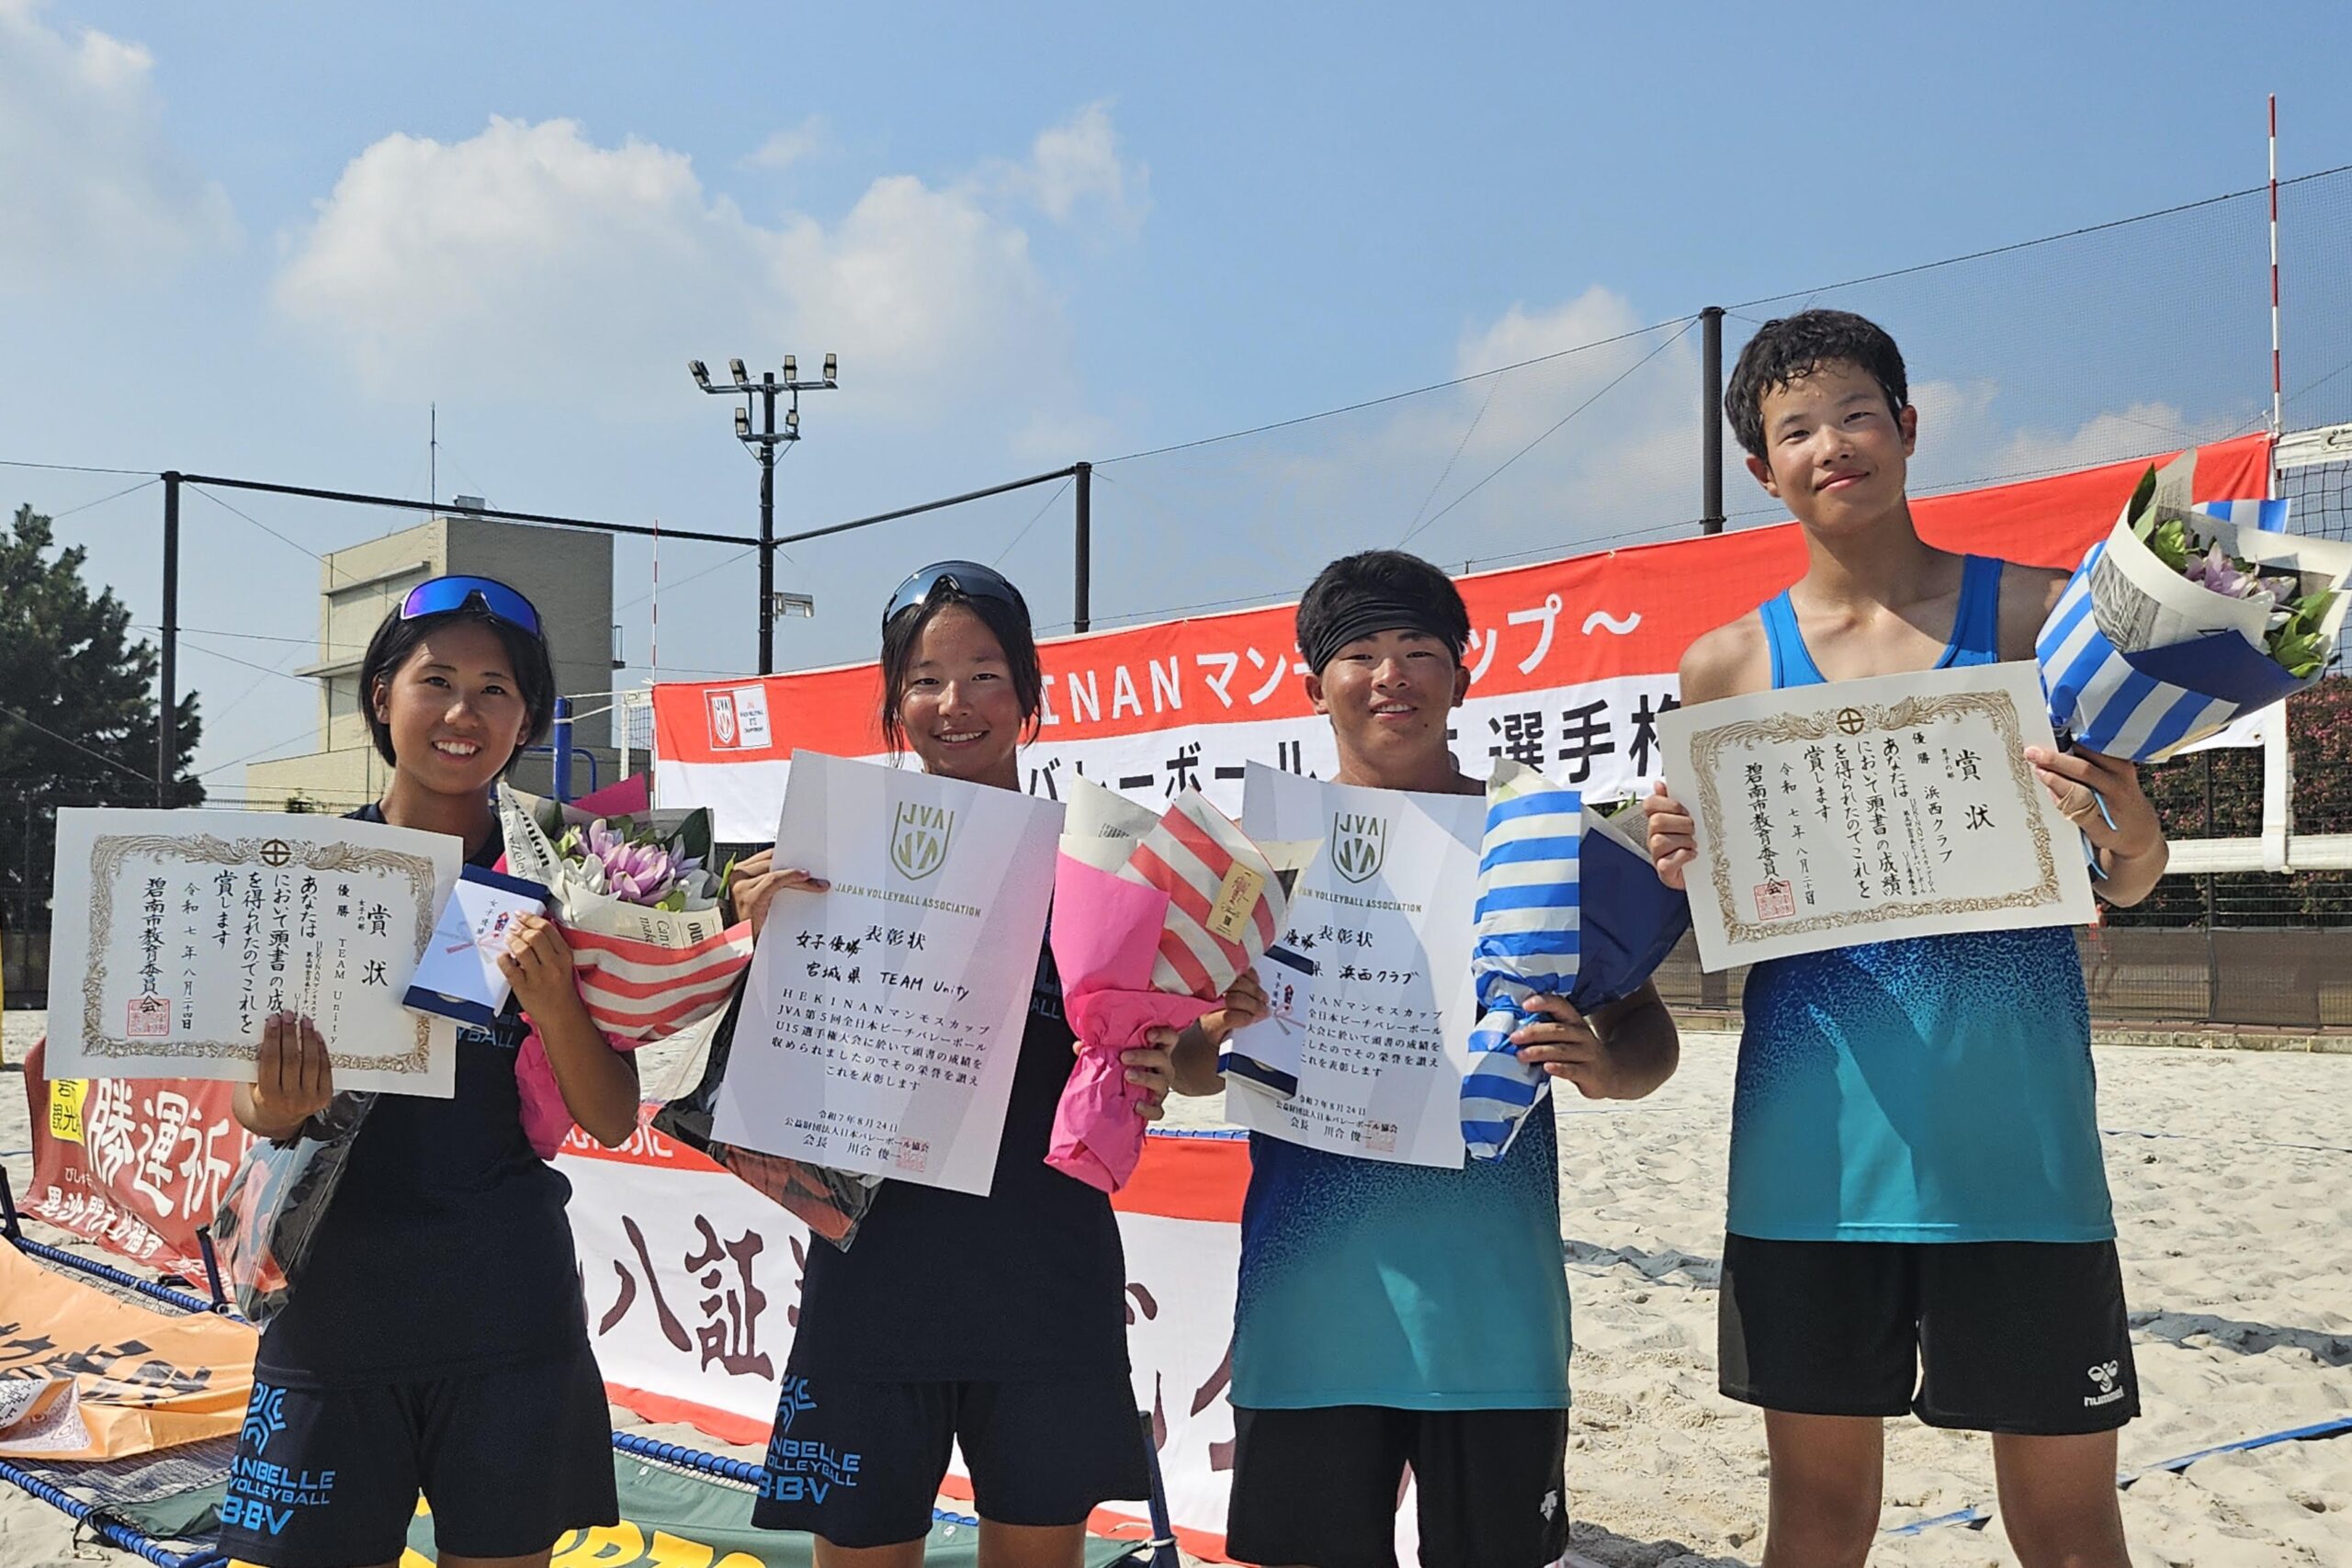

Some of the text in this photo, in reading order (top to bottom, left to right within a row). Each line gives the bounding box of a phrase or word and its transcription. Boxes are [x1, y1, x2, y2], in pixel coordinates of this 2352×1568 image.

[1803, 744, 1831, 824] 賞します
[1883, 737, 1909, 798] あなたは
[1955, 749, 1996, 830] 賞状
[902, 803, 944, 830] JVA
[1340, 813, 1379, 837] JVA
[1744, 761, 1785, 896] 碧南市教育委員会
[211, 869, 239, 950] 賞します
[300, 874, 318, 939] あなたは
[834, 883, 982, 918] JAPAN VOLLEYBALL ASSOCIATION
[1315, 890, 1364, 908] VOLLEYBALL
[1365, 899, 1422, 913] ASSOCIATION
[138, 876, 167, 1013] 碧南市教育委員会
[267, 873, 291, 1016] において頭書の成
[361, 903, 393, 987] 賞状
[864, 924, 926, 951] 表彰状
[1318, 924, 1374, 948] 表彰状
[806, 960, 970, 1002] 宮城県 TEAM Unity
[1339, 964, 1420, 985] 浜西クラブ
[1302, 1040, 1439, 1068] したのでその栄誉を讃え
[825, 1065, 921, 1091] これを表彰します
[229, 1476, 331, 1506] VOLLEYBALL
